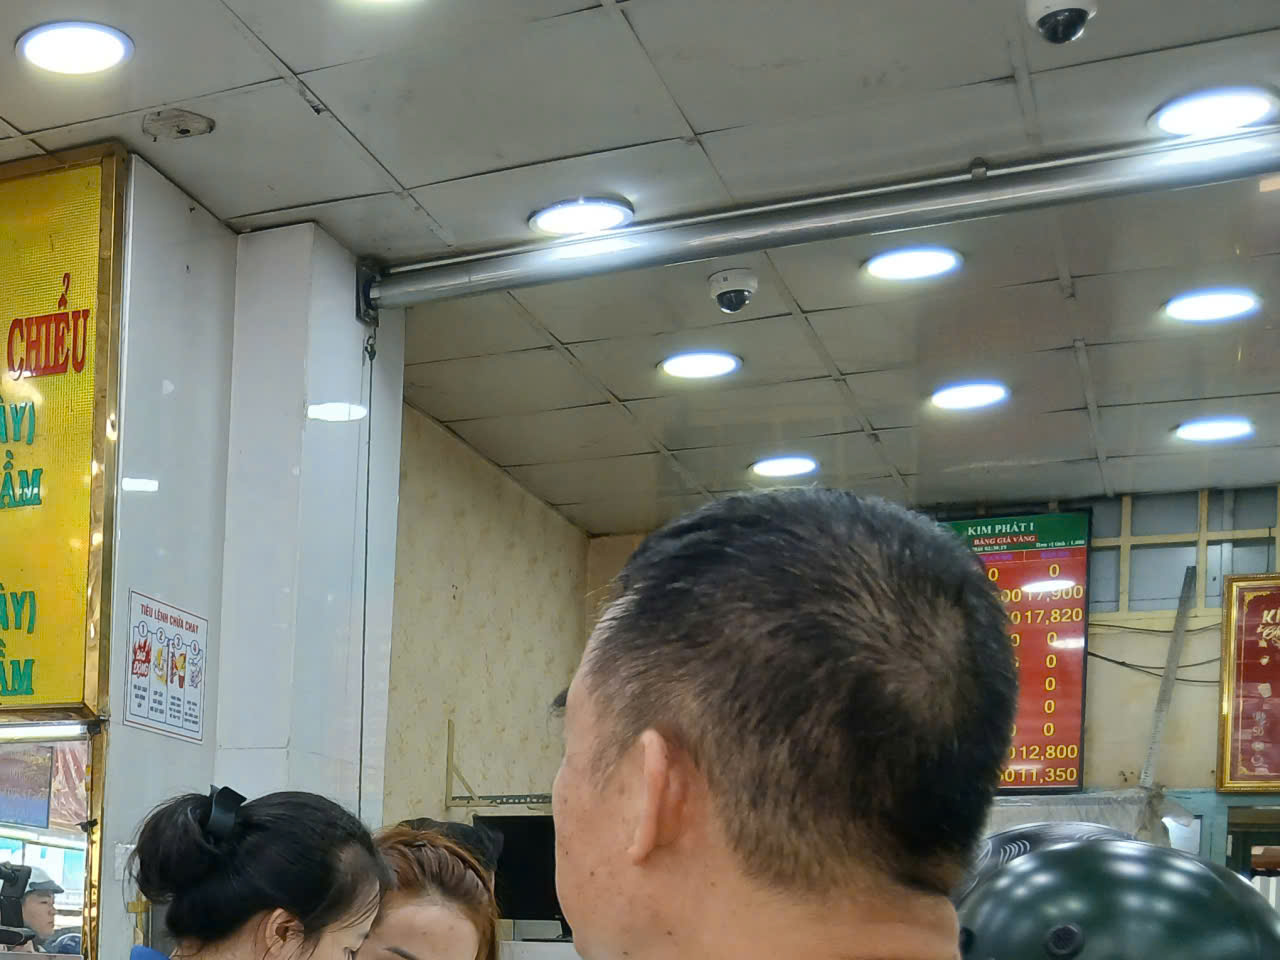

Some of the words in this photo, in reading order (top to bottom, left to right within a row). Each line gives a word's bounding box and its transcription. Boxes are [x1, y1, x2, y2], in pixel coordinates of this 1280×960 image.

[7, 272, 90, 381] CHIỂU
[967, 525, 992, 536] KIM
[995, 521, 1027, 534] PHÁT
[988, 567, 999, 581] 0
[1049, 564, 1060, 577] 0
[1025, 607, 1083, 625] 17,820
[159, 630, 164, 641] 2
[1046, 654, 1057, 668] 0
[1045, 677, 1056, 691] 0
[1044, 699, 1055, 713] 0
[1043, 722, 1054, 736] 0
[1020, 744, 1078, 760] 12,800
[1018, 767, 1077, 783] 11,350
